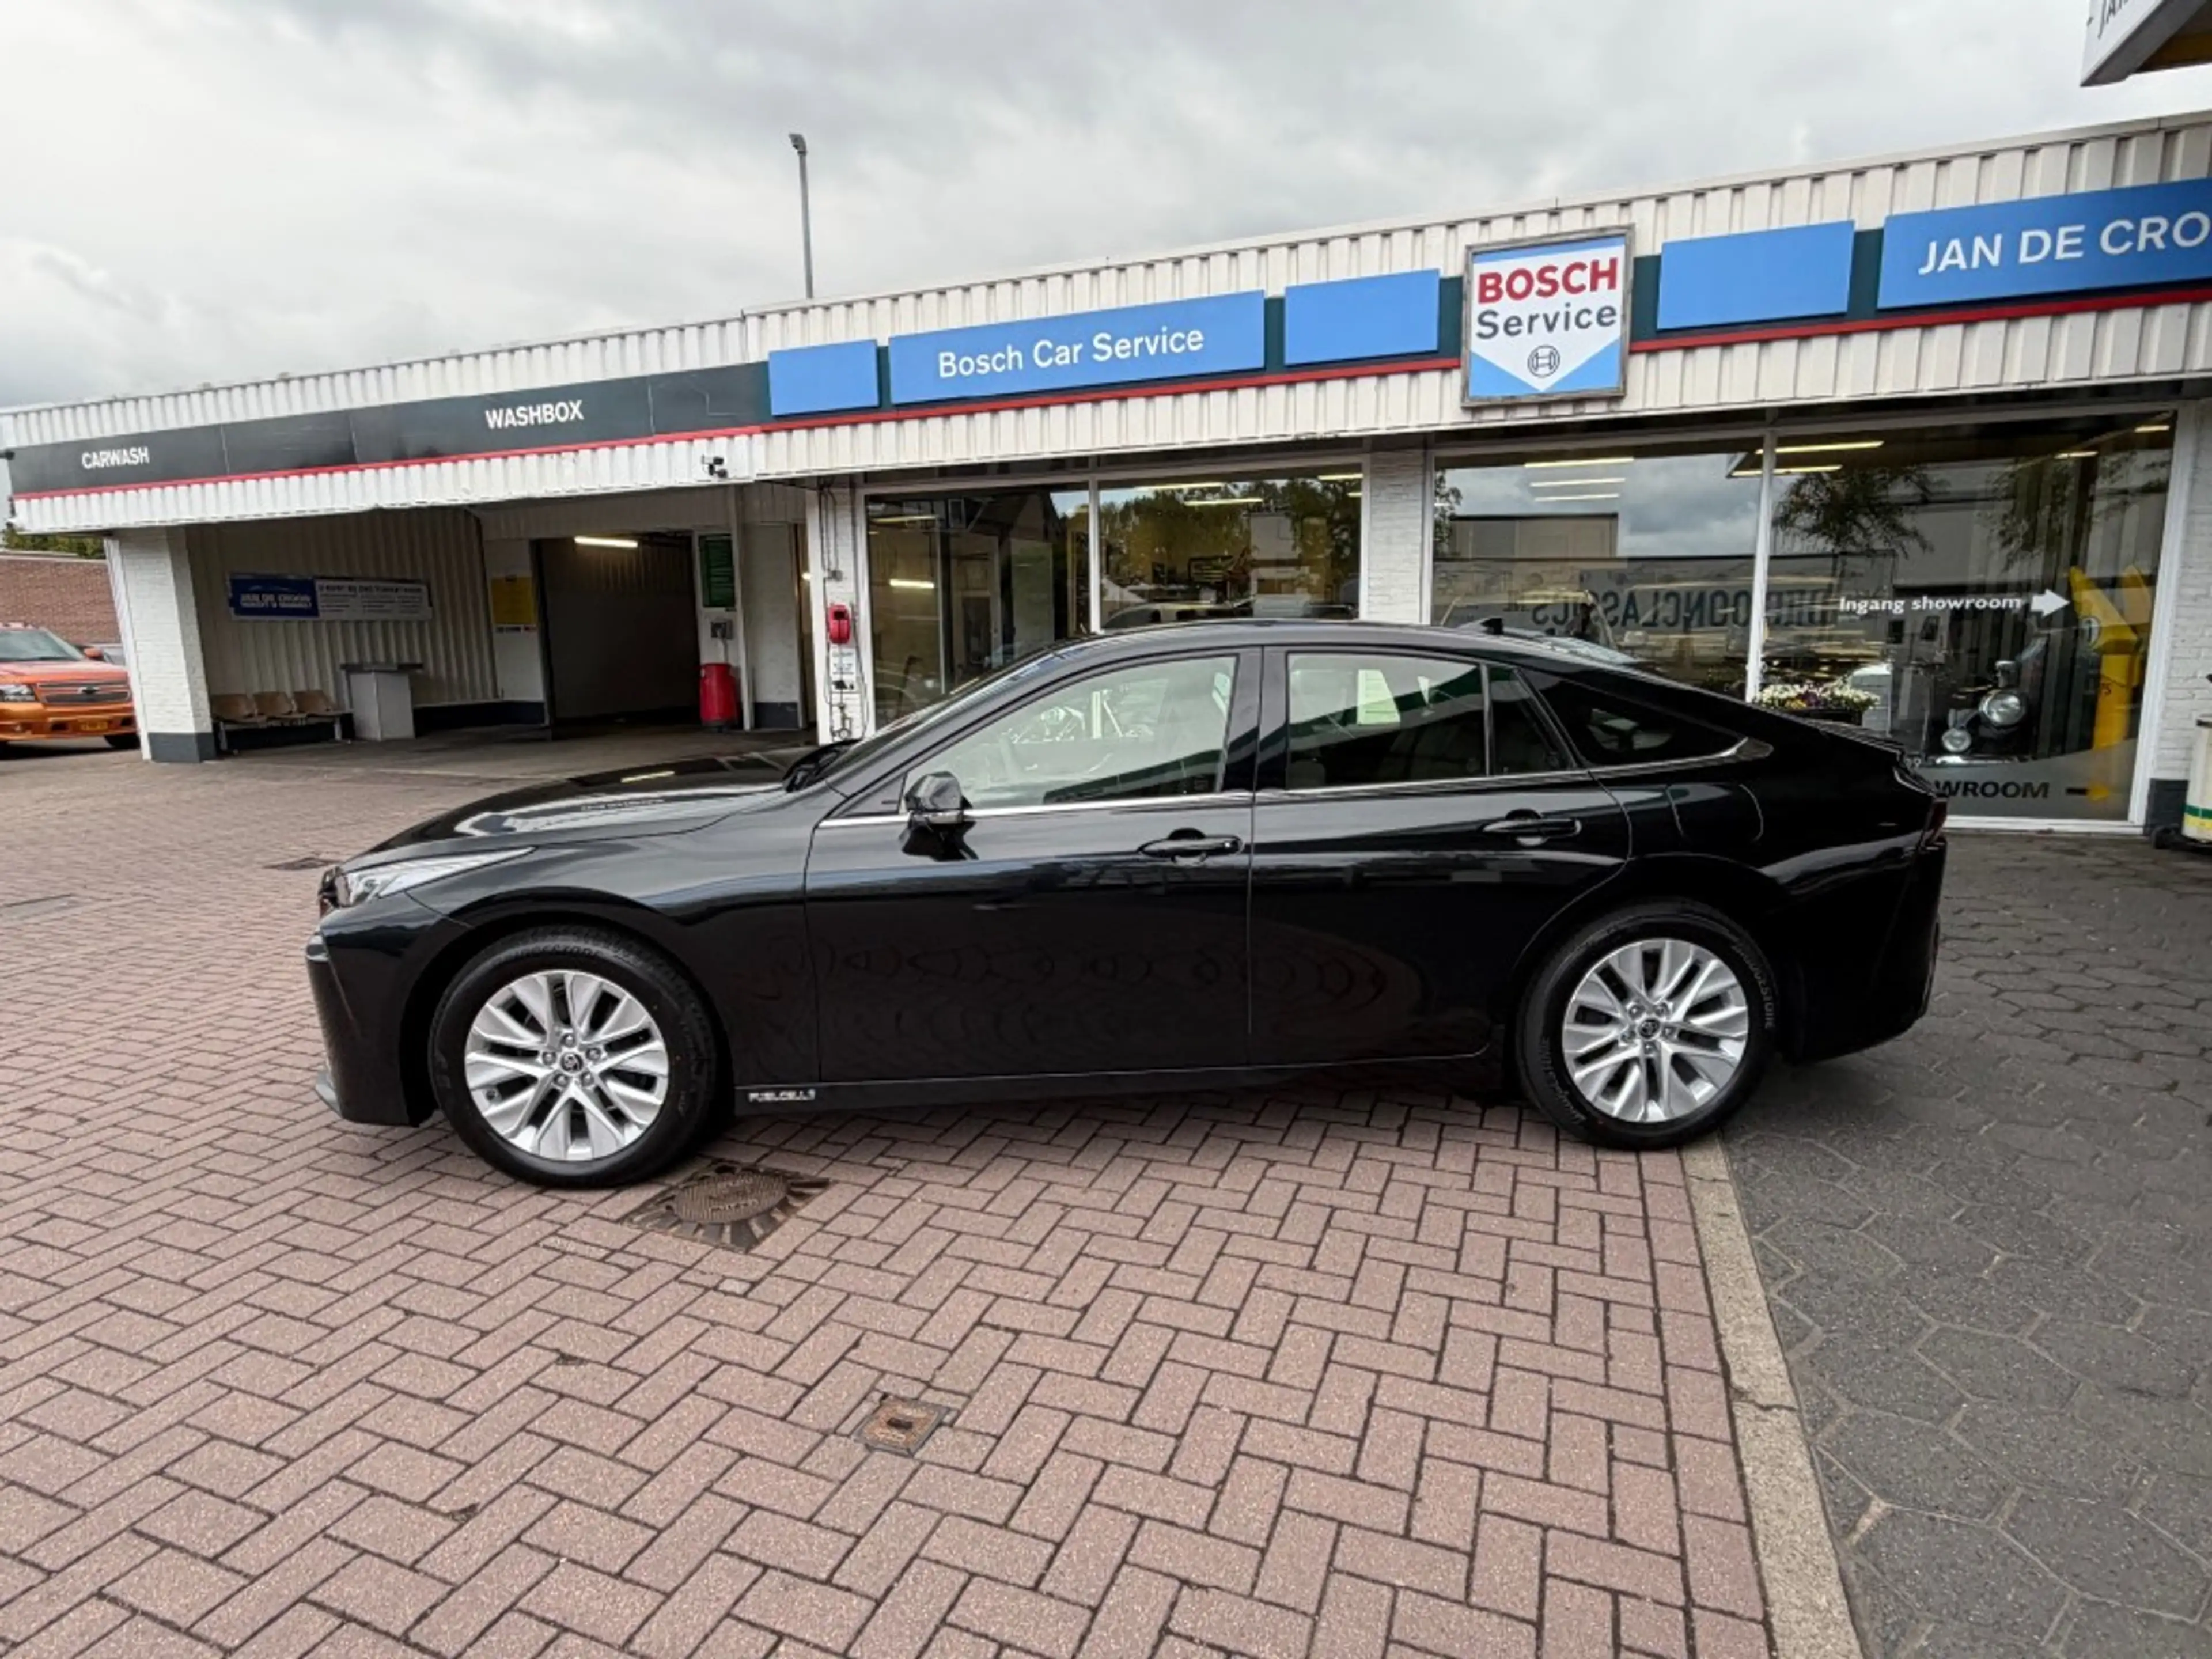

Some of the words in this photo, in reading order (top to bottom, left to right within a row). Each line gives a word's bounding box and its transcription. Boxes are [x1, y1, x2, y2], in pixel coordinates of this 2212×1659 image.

[1918, 234, 2002, 275] JAN
[2019, 225, 2086, 264] DE
[2100, 211, 2211, 255] CRO
[1478, 257, 1618, 304] BOSCH
[1476, 301, 1617, 339] Service
[938, 344, 1023, 378] Bosch
[1033, 339, 1083, 368] Car
[1092, 326, 1205, 362] Service
[484, 400, 584, 429] WASHBOX
[82, 446, 150, 470] CARWASH
[1839, 596, 1905, 615] Ingang
[1911, 596, 2021, 612] showroom
